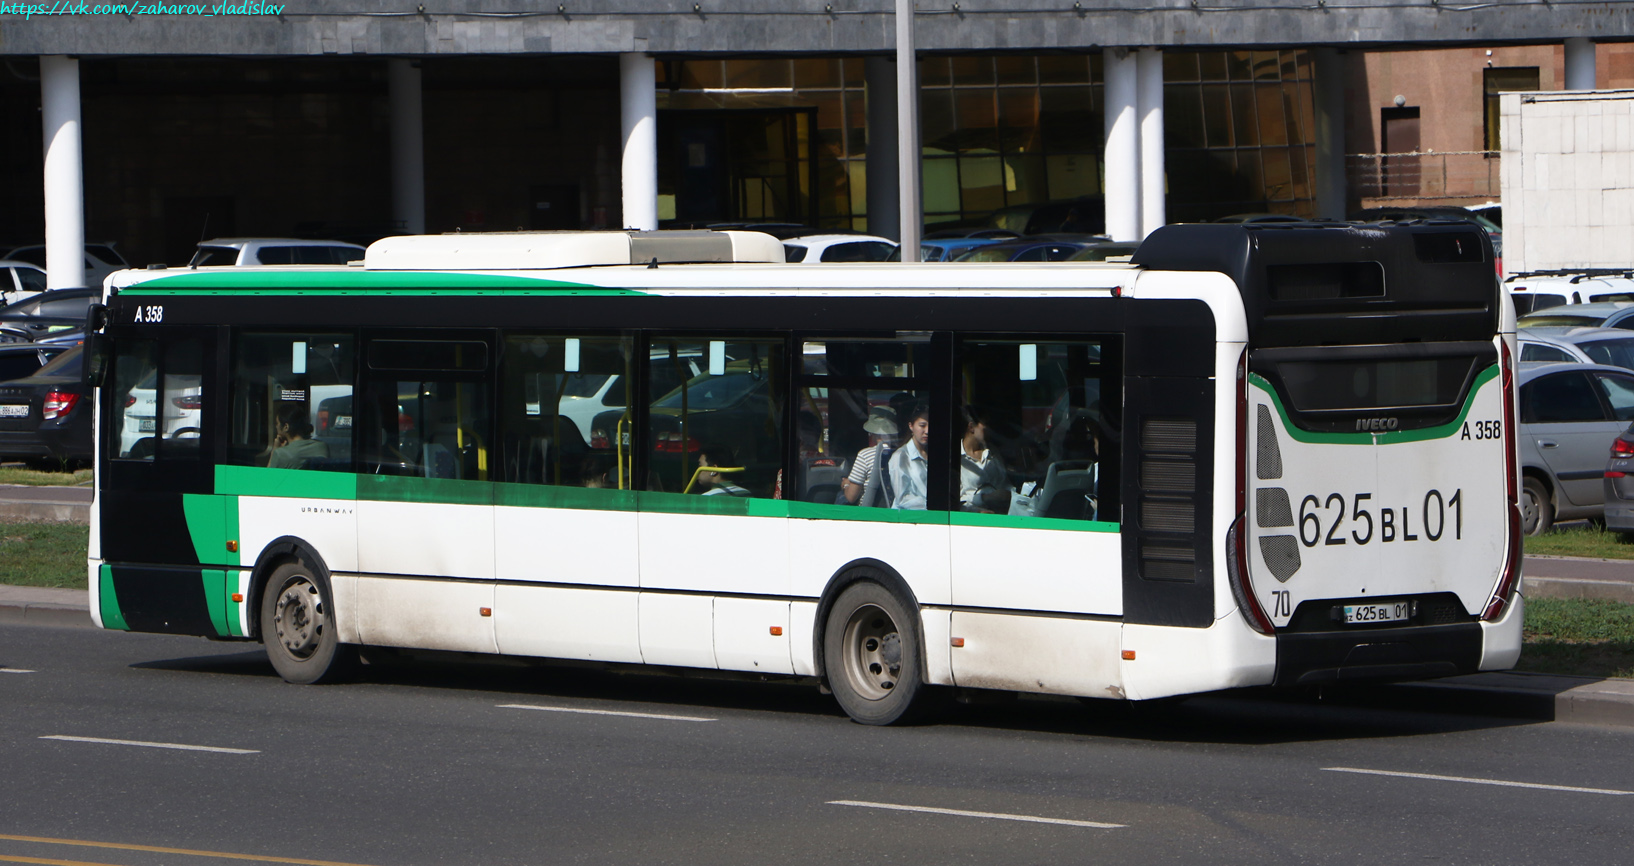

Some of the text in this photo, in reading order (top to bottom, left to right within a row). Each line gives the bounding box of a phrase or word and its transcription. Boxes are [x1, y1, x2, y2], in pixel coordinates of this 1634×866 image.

[134, 305, 163, 323] A 358
[1355, 417, 1399, 431] IVECO
[1461, 420, 1501, 441] A 358
[301, 506, 353, 514] URBANWAY
[1272, 590, 1290, 617] 70
[1355, 606, 1376, 621] 625
[1378, 608, 1390, 620] BL
[1395, 604, 1407, 618] 01
